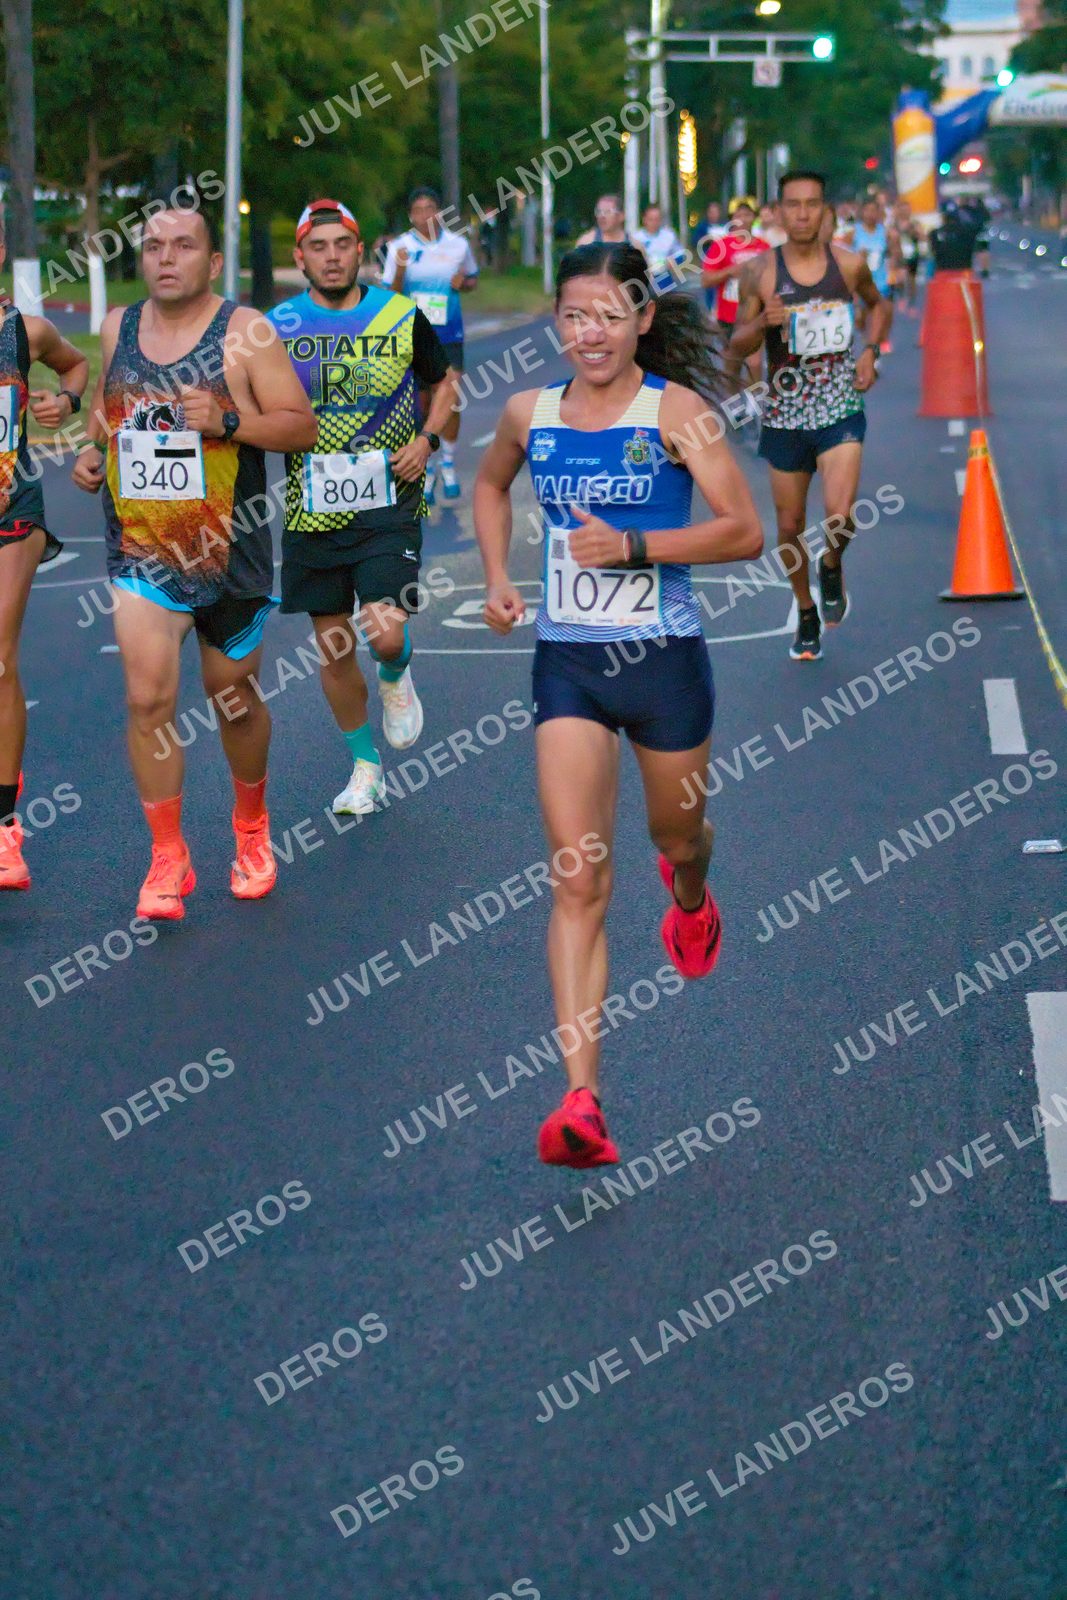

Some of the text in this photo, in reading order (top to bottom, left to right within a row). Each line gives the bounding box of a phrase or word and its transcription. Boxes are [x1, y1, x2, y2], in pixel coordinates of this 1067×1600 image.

[804, 325, 845, 349] 215
[131, 460, 188, 490] 340
[323, 476, 376, 504] 804
[554, 569, 654, 612] 1072
